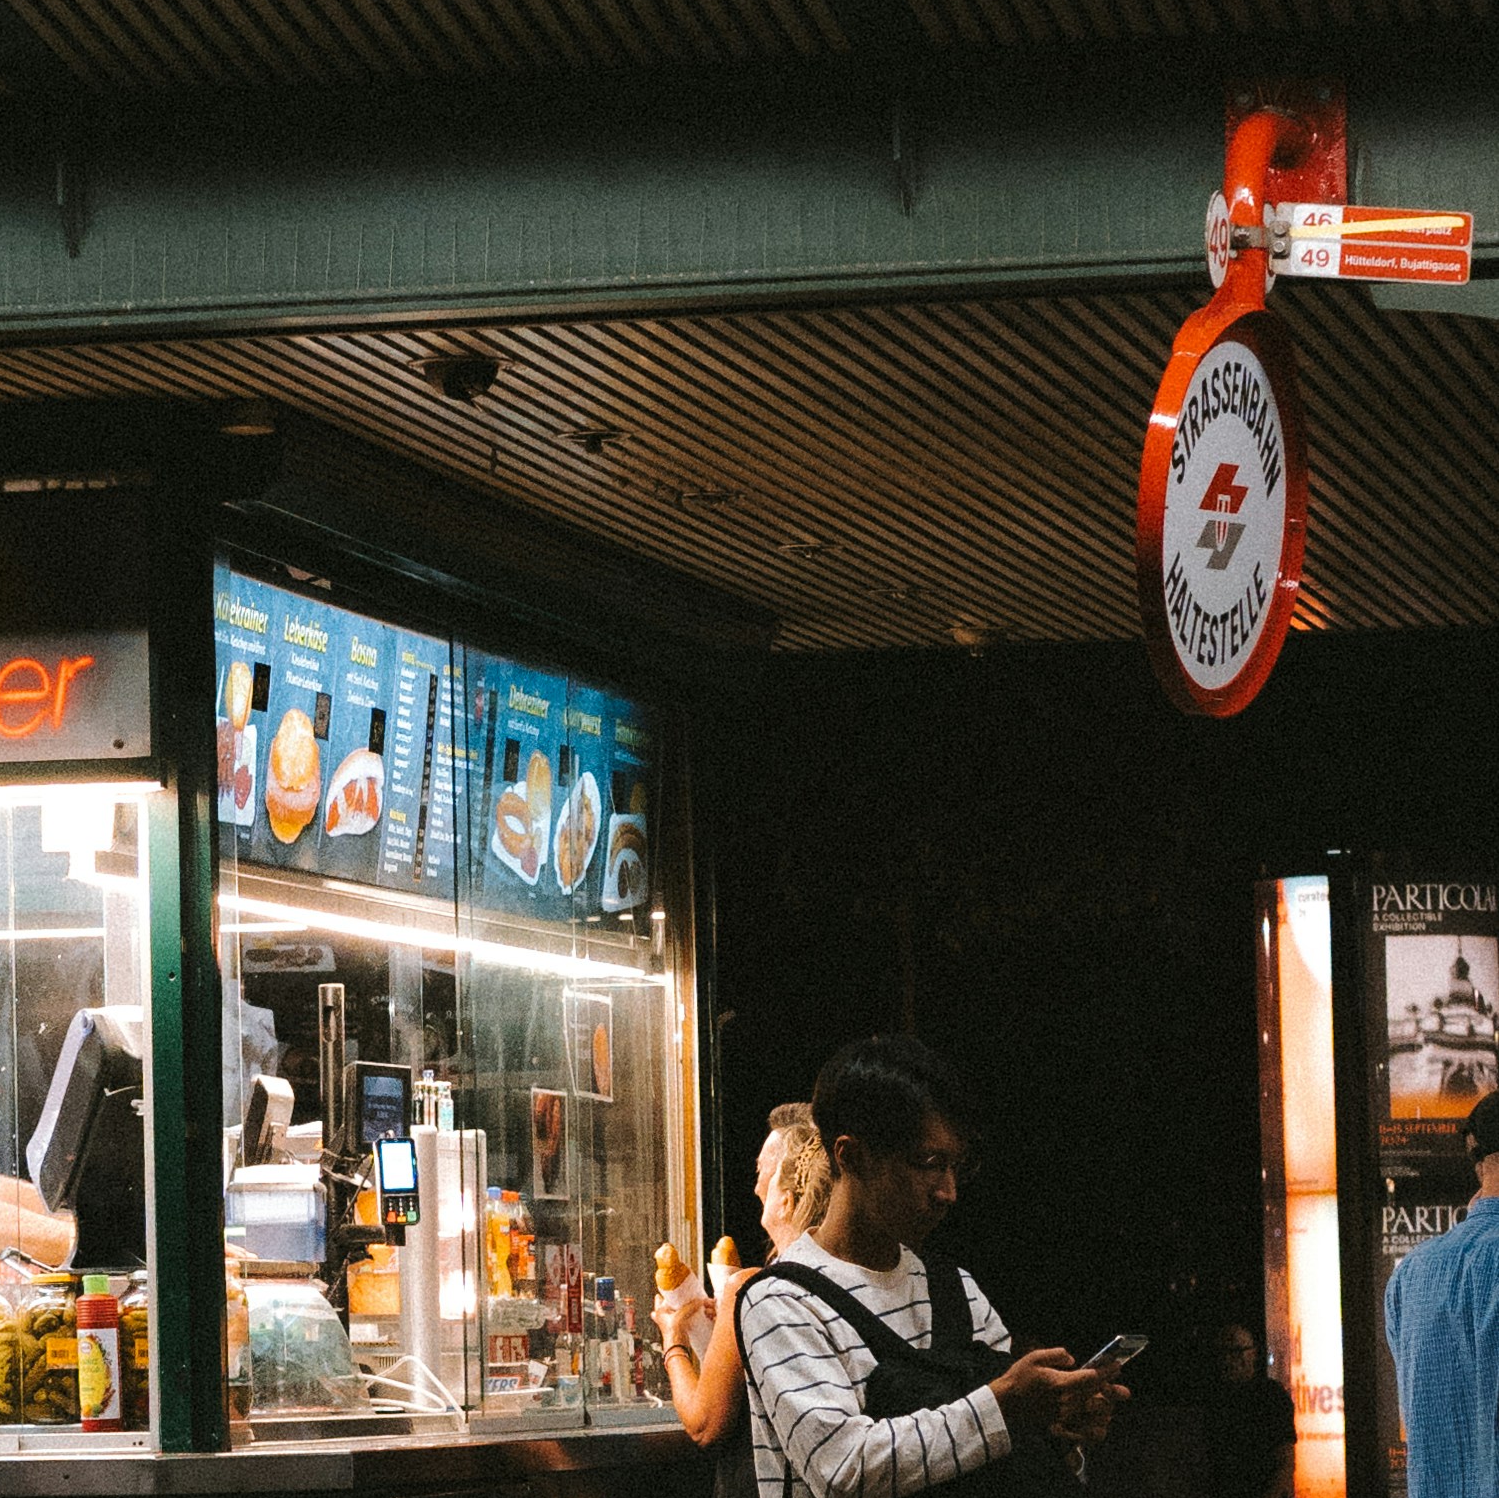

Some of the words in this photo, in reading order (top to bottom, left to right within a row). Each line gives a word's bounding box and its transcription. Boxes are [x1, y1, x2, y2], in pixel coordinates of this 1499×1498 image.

[1209, 218, 1228, 268] 49
[1301, 249, 1330, 267] 49
[1345, 254, 1398, 270] Hütteldorf,
[1400, 258, 1462, 273] Bujattigasse
[1171, 360, 1282, 499] STRASSENBAHN
[216, 592, 269, 634] Käekrainer
[1163, 551, 1268, 668] HALTESTELLE
[284, 614, 329, 654] Leberkäse
[350, 636, 378, 669] Bosna
[1373, 913, 1380, 922] A
[1383, 912, 1443, 922] COLLECTIBLE
[1373, 922, 1426, 932] EXHIBITION
[1381, 1205, 1468, 1234] PARTIC
